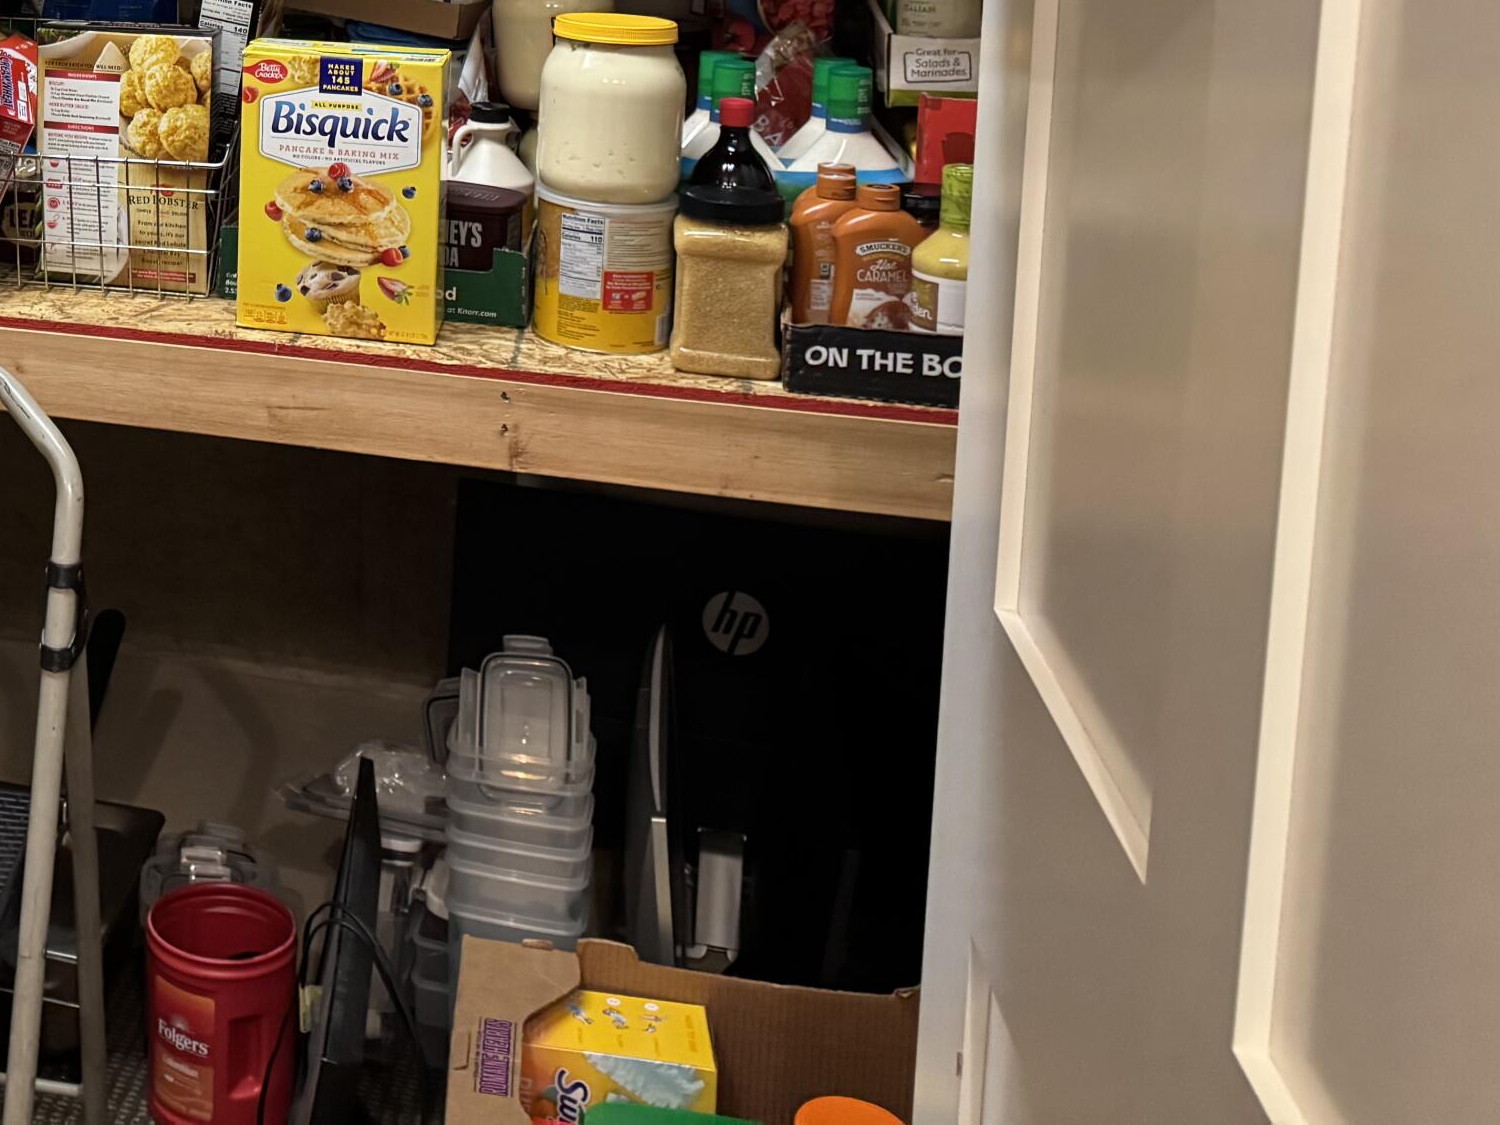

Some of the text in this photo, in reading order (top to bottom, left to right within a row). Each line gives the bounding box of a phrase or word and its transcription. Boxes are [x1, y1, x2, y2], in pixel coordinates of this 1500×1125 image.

[915, 48, 941, 56] Great
[327, 63, 355, 71] MAKES
[915, 57, 961, 68] Salads &
[258, 63, 282, 74] Betty
[910, 67, 967, 78] Marinades
[254, 70, 285, 80] Crocker
[331, 75, 350, 85] 145
[322, 84, 359, 93] PANCAKES
[271, 100, 410, 148] Bisquick
[278, 143, 401, 161] PANCAKE & BAKING MIX
[128, 195, 151, 206] RED
[562, 214, 586, 223] Nutrition
[590, 235, 603, 243] 110
[869, 259, 898, 271] Hot
[856, 268, 909, 282] CARAMEL
[456, 307, 497, 318] Knorr.com
[804, 345, 849, 368] ON
[856, 349, 915, 374] THE
[708, 591, 764, 656] hp
[157, 1018, 210, 1057] Folgers
[480, 1019, 512, 1096] ROMAINE HEARTS
